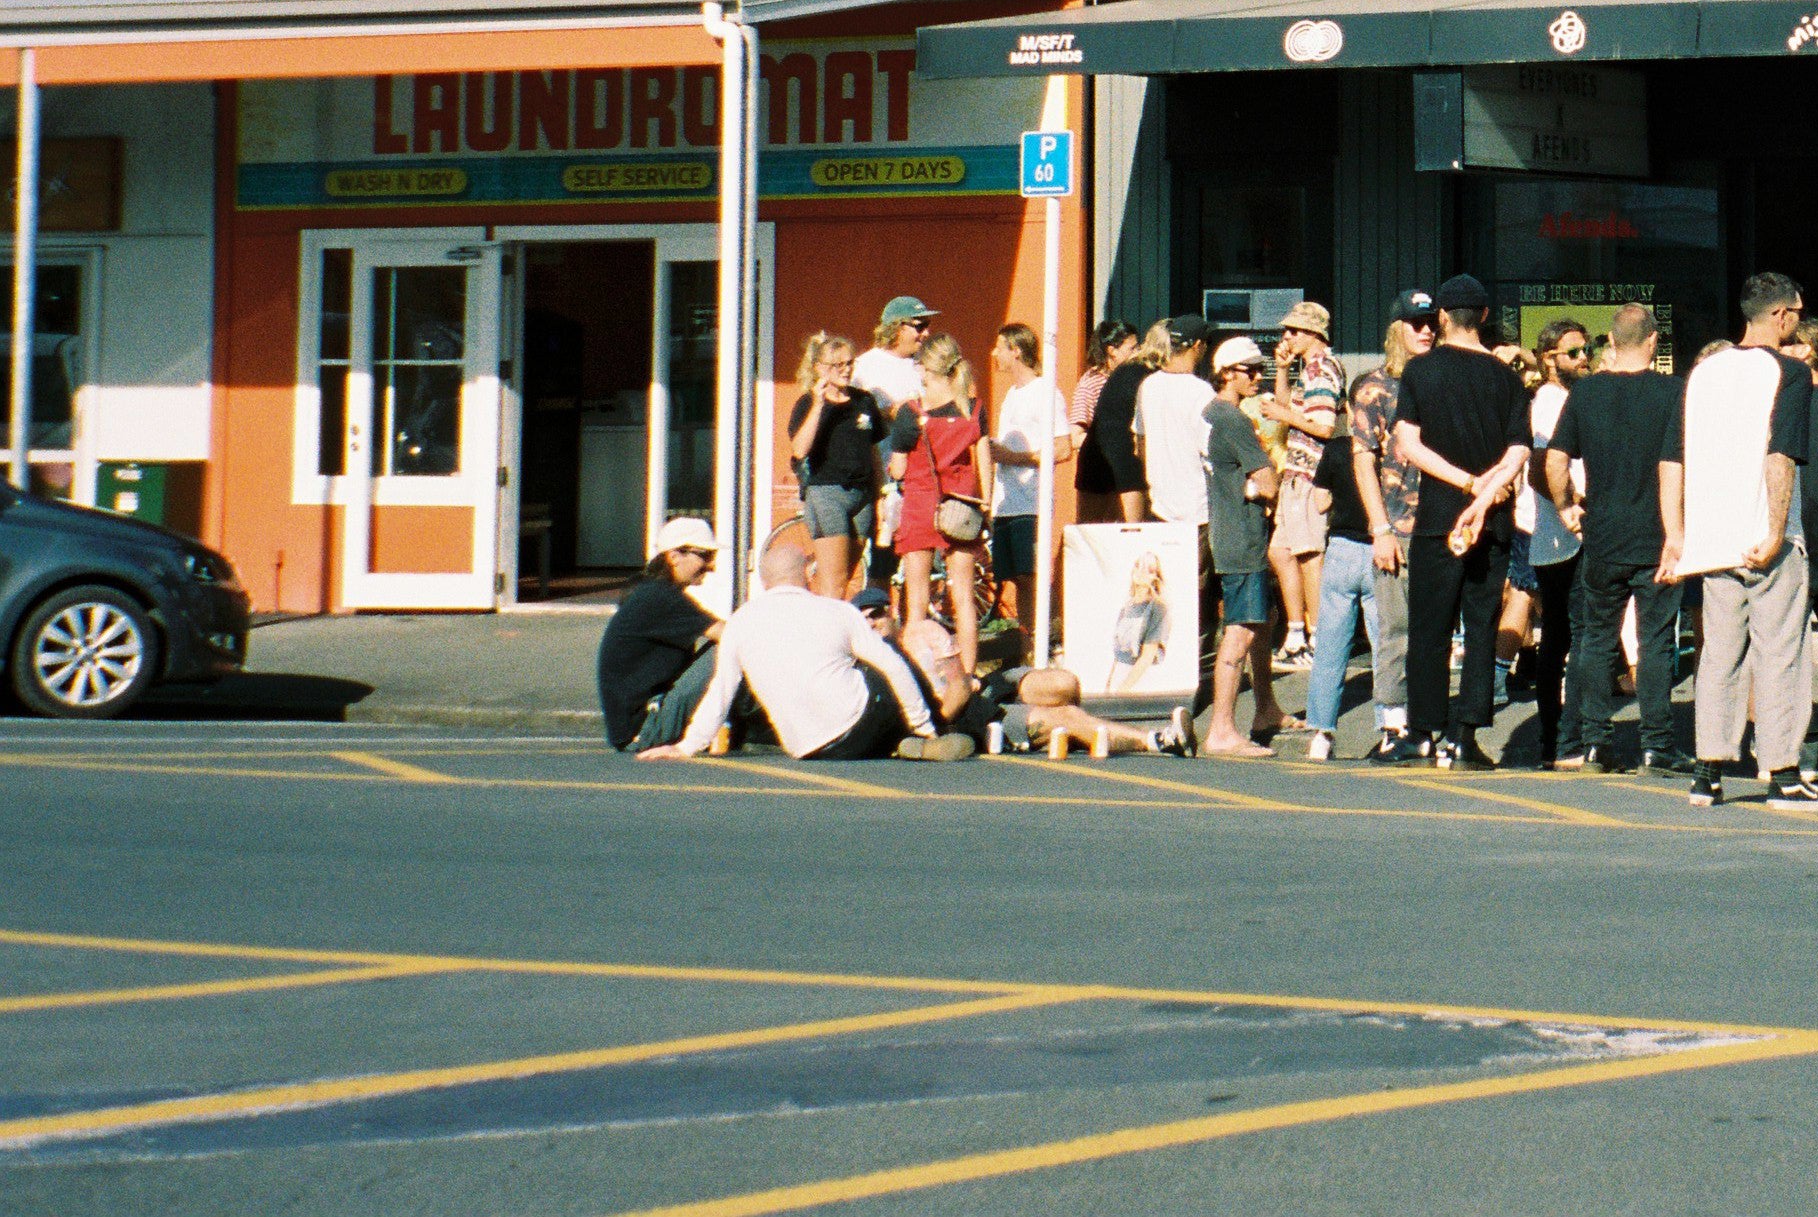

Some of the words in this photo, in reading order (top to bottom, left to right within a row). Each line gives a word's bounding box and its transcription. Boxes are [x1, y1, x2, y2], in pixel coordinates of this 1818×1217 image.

[1009, 52, 1040, 65] MAD
[1041, 50, 1083, 63] MINDS
[1040, 136, 1057, 160] P
[573, 167, 619, 189] SELF
[624, 164, 700, 186] SERVICE
[824, 162, 880, 182] OPEN
[885, 162, 894, 180] 7
[900, 160, 952, 179] DAYS
[1034, 163, 1055, 182] 60
[337, 174, 391, 192] WASH
[397, 174, 410, 190] N
[416, 172, 453, 190] DRY
[1519, 284, 1546, 302] BE
[1550, 284, 1605, 302] HERE
[1609, 284, 1655, 302] NOW
